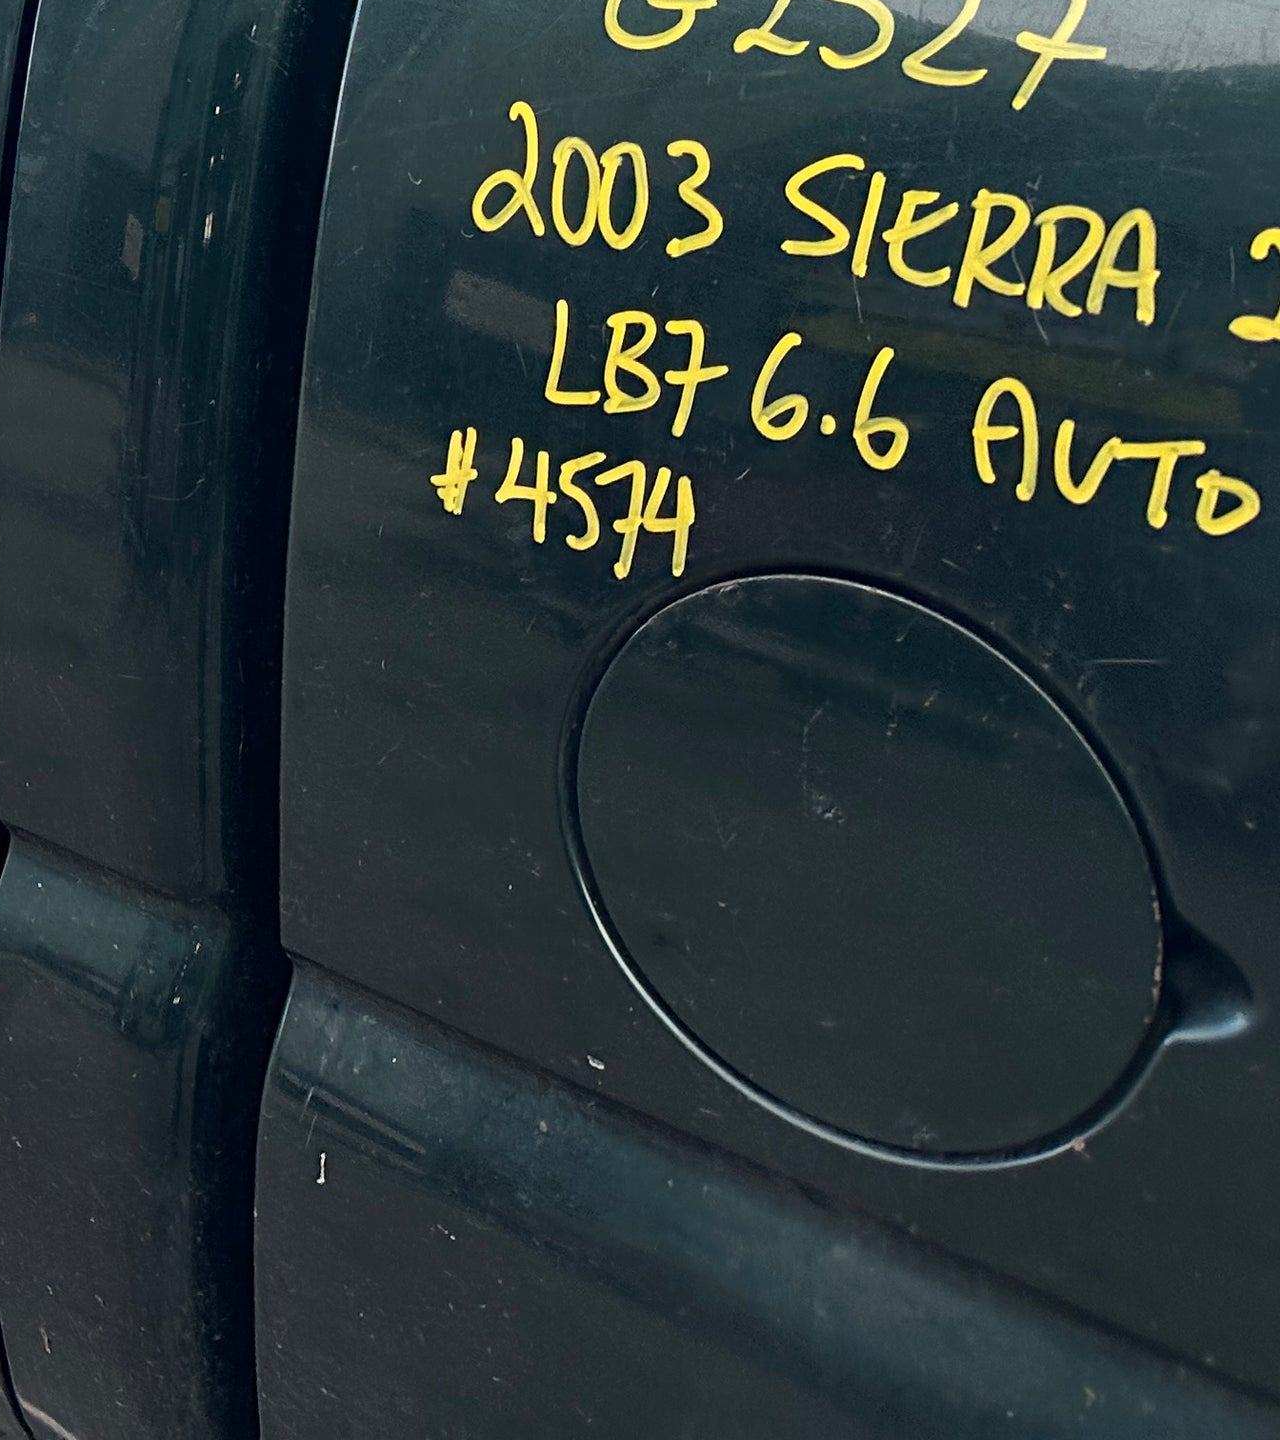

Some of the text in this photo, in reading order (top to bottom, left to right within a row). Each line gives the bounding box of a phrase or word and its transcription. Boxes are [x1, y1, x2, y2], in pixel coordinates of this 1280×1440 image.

[471, 100, 726, 258] 2003
[780, 152, 1161, 327] SIERRA
[430, 426, 697, 580] #4574
[543, 300, 1262, 537] LB7 6.6 AUTO
